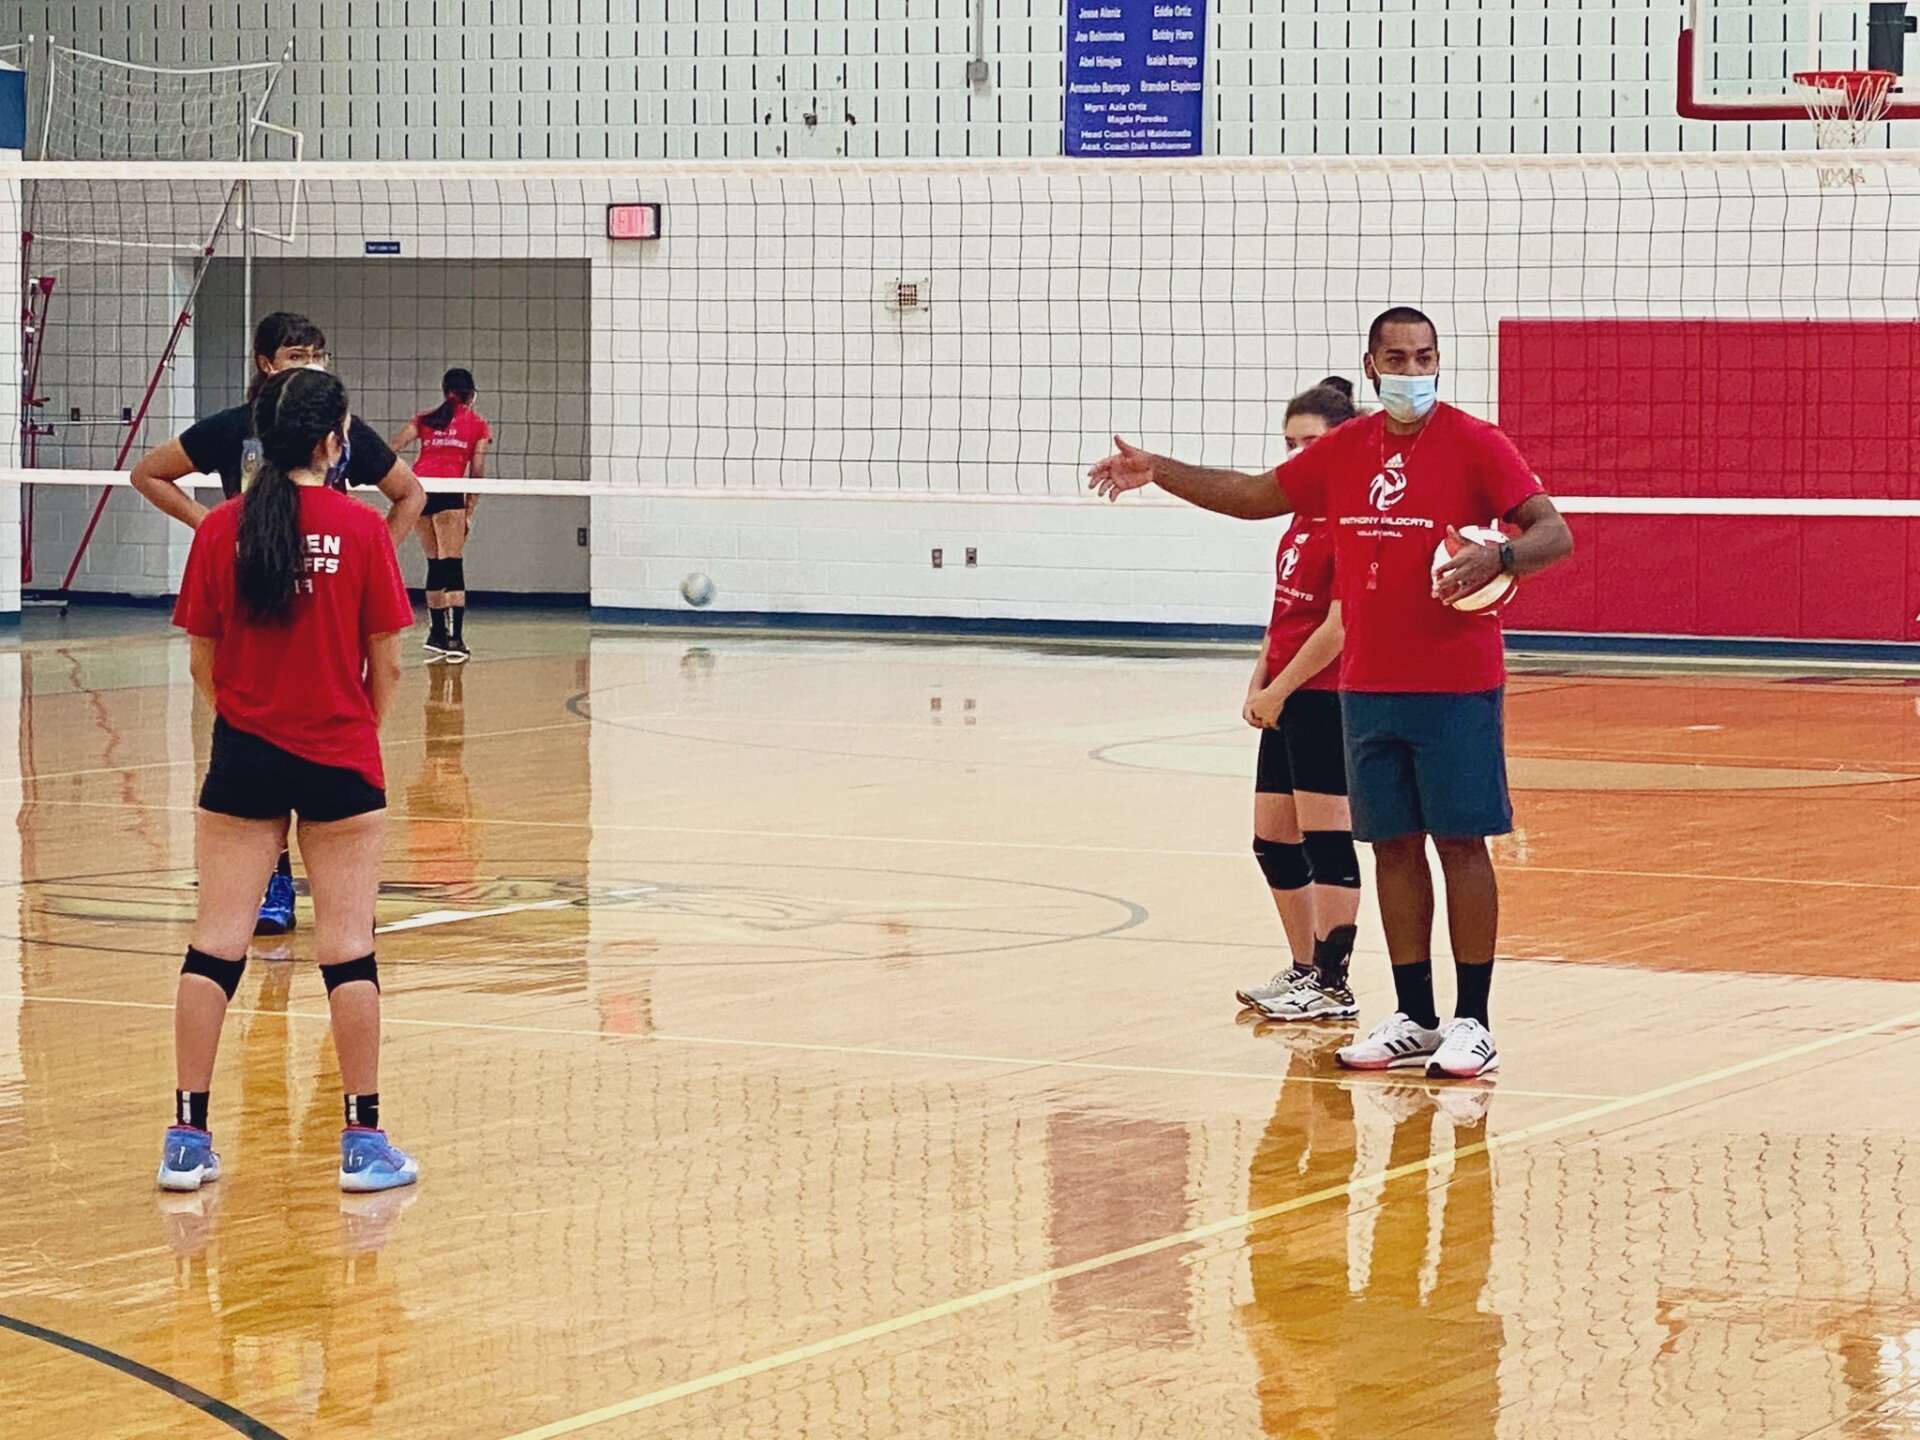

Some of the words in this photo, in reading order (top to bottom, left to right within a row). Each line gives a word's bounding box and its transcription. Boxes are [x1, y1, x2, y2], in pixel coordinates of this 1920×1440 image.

[1174, 5, 1192, 17] Ortiz
[1075, 31, 1088, 42] Joe
[1152, 29, 1174, 43] Bobby
[1128, 103, 1147, 111] Ortiz
[1080, 130, 1102, 138] Head
[1103, 130, 1130, 138] Coach
[1103, 143, 1130, 151] Coach
[618, 208, 646, 233] EXIT
[305, 534, 341, 555] EN
[303, 557, 340, 574] FFS
